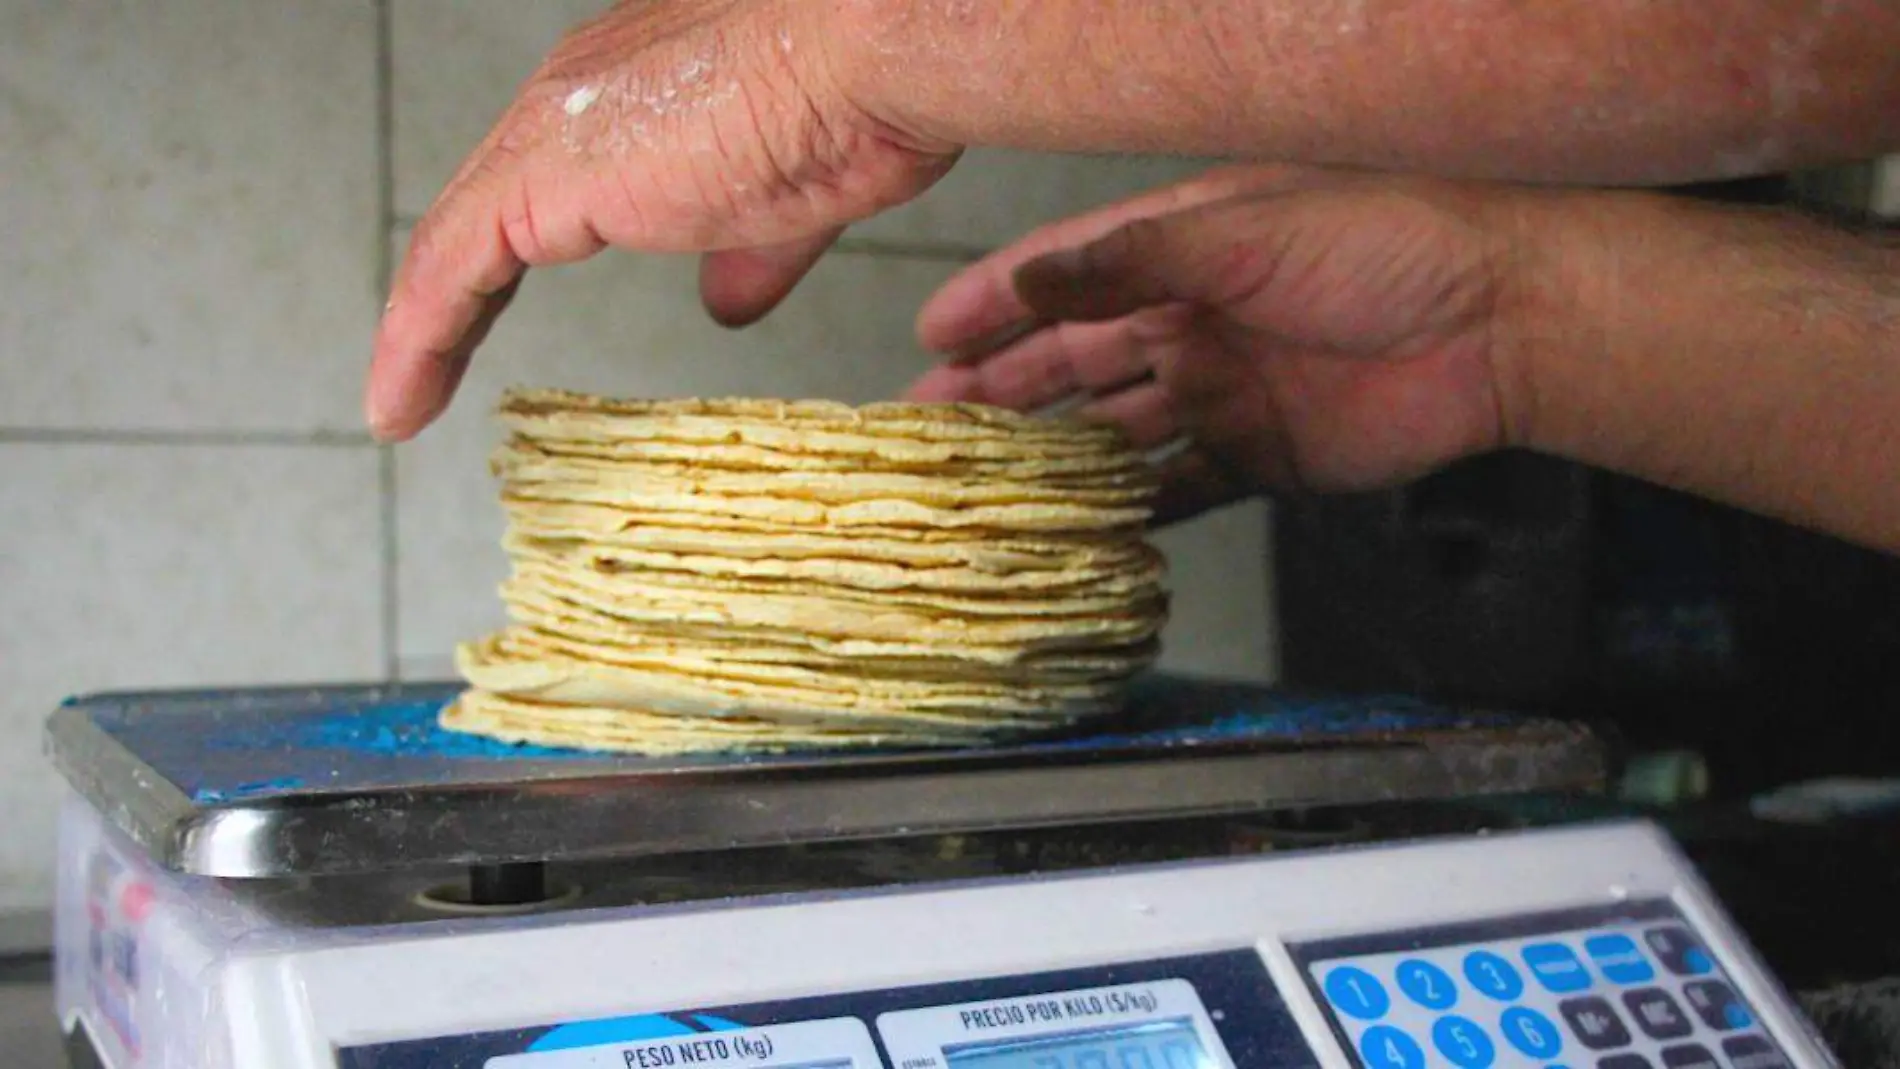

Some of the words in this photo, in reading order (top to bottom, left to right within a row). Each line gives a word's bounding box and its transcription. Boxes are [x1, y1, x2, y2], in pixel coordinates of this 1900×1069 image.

[1346, 977, 1370, 1008] 1
[1413, 968, 1441, 999] 2
[1480, 961, 1507, 991] 3
[959, 1004, 1025, 1030] PRECIO
[1025, 999, 1064, 1023] POR
[1063, 994, 1103, 1019] KILO
[1450, 1024, 1478, 1059] 5
[1517, 1015, 1546, 1049] 6
[623, 1045, 675, 1069] PESO
[678, 1039, 730, 1064] NETO
[733, 1033, 774, 1060] (kg)
[1383, 1036, 1407, 1068] 4
